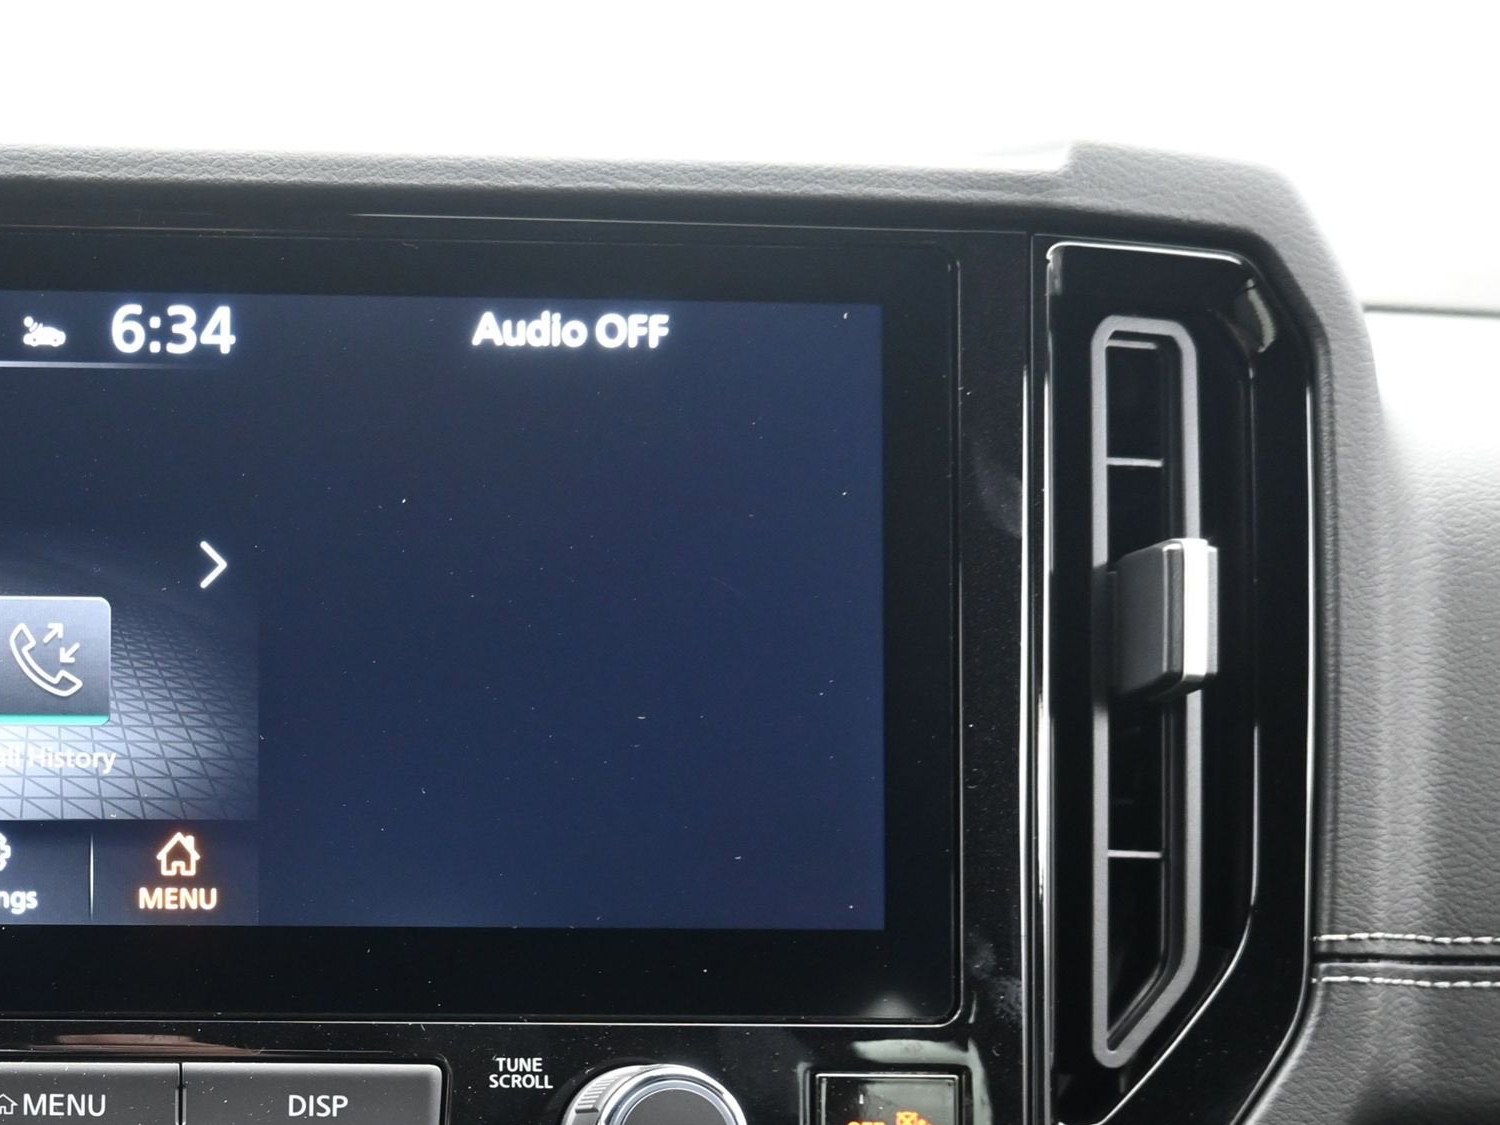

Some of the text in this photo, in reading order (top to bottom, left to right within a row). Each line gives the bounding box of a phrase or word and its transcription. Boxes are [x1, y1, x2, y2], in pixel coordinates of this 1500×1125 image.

[110, 303, 237, 355] 6:34
[471, 309, 670, 349] Audio OFF
[29, 748, 116, 774] History
[138, 886, 217, 910] MENU
[495, 1057, 543, 1073] TUNE
[488, 1073, 554, 1089] SCROLL
[23, 1093, 106, 1117] MENU
[288, 1094, 349, 1118] DISP
